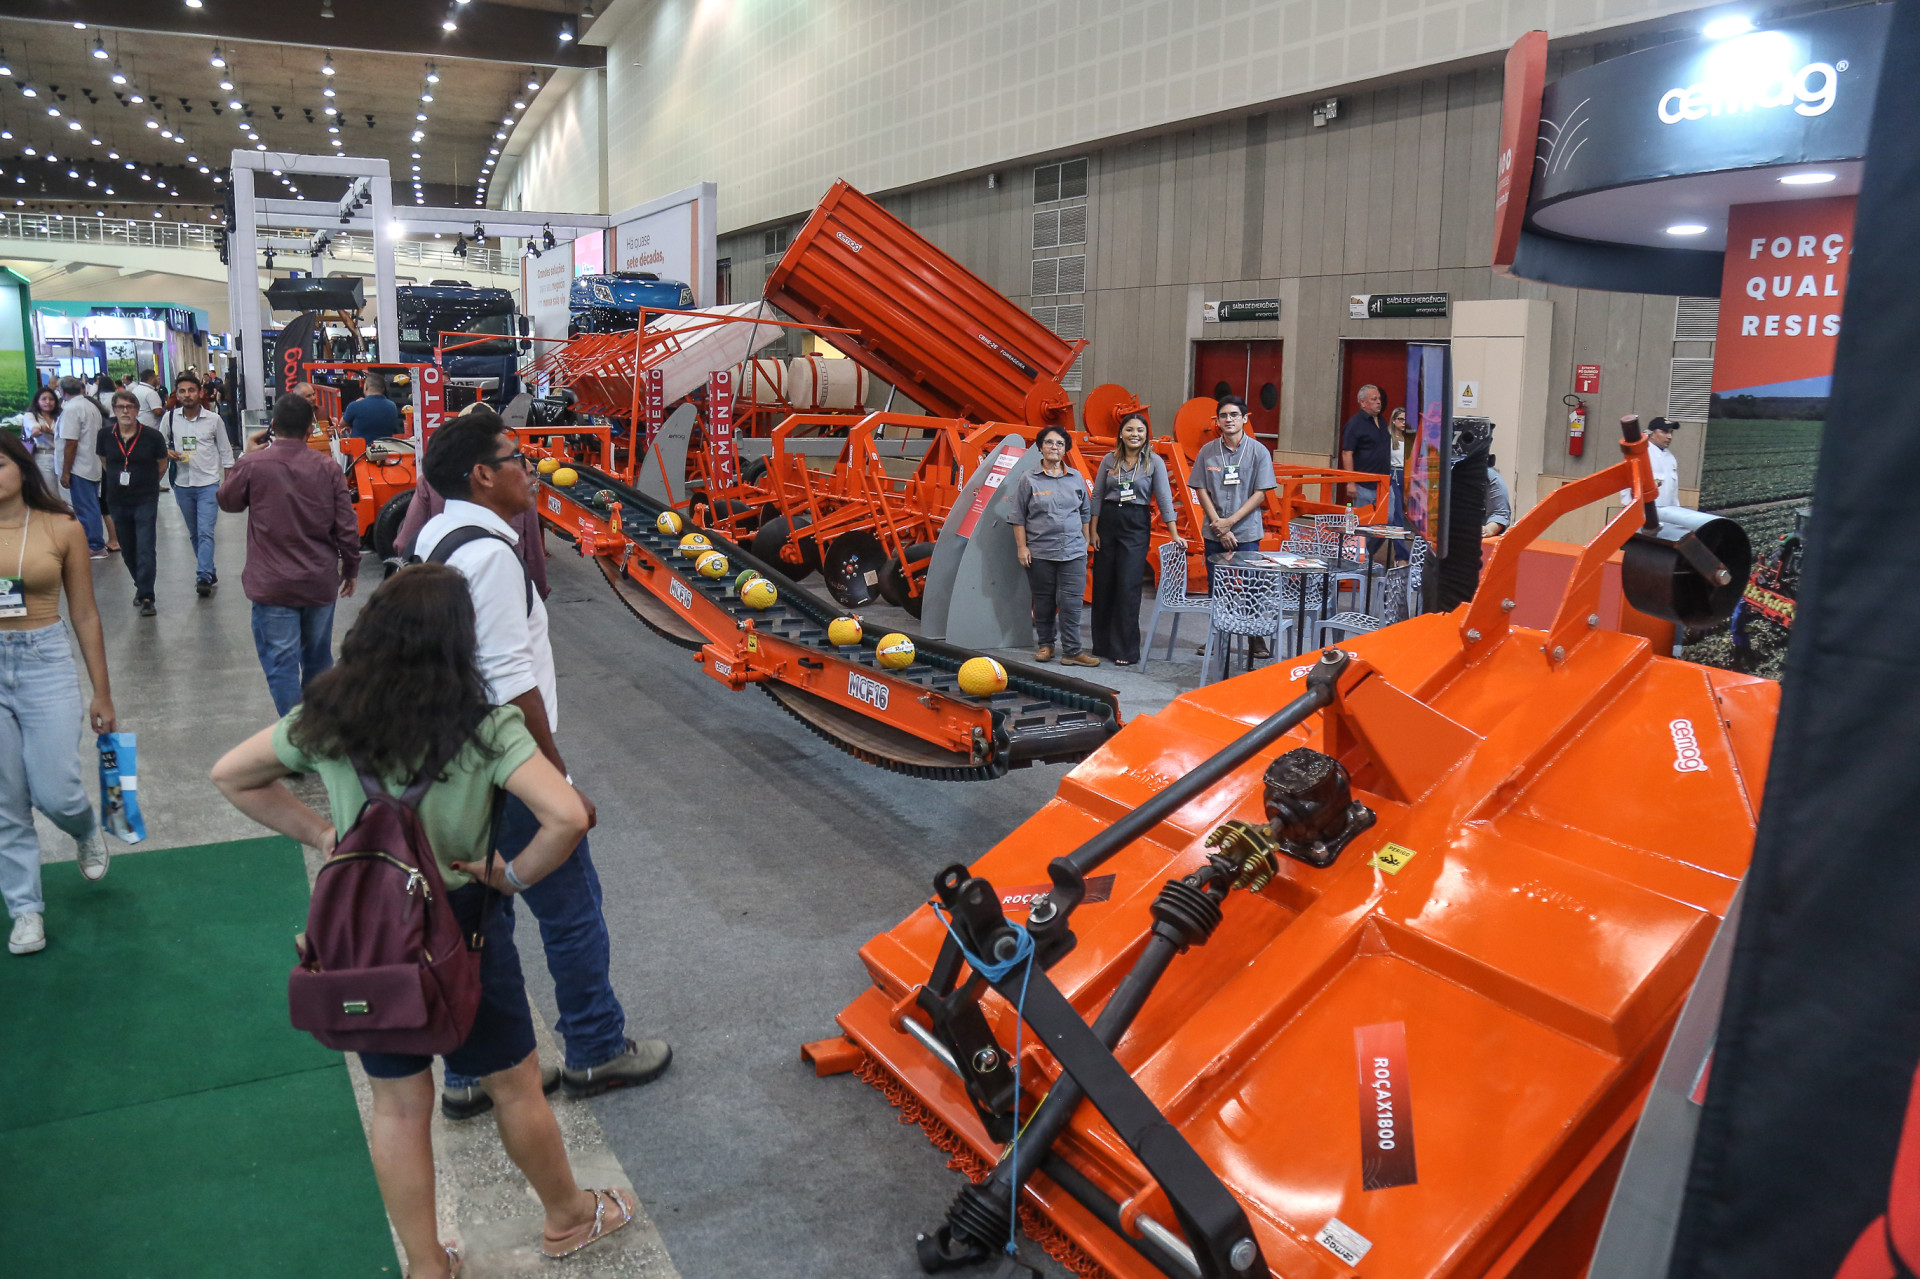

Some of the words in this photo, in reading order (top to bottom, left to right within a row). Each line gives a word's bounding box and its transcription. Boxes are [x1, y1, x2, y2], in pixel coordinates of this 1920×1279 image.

[836, 231, 862, 252] cemag
[626, 256, 639, 269] sete
[639, 249, 665, 267] décadas,
[1386, 295, 1402, 305] SAÍDA
[1411, 294, 1446, 304] EMERGÊNCIA
[1746, 274, 1839, 301] QUAL
[284, 347, 303, 393] mag
[848, 670, 890, 711] MCF16
[1668, 718, 1708, 773] cemag
[1388, 845, 1411, 857] PERIGO
[1372, 1056, 1396, 1151] ROÇAX1800
[1322, 1235, 1354, 1262] cemag
